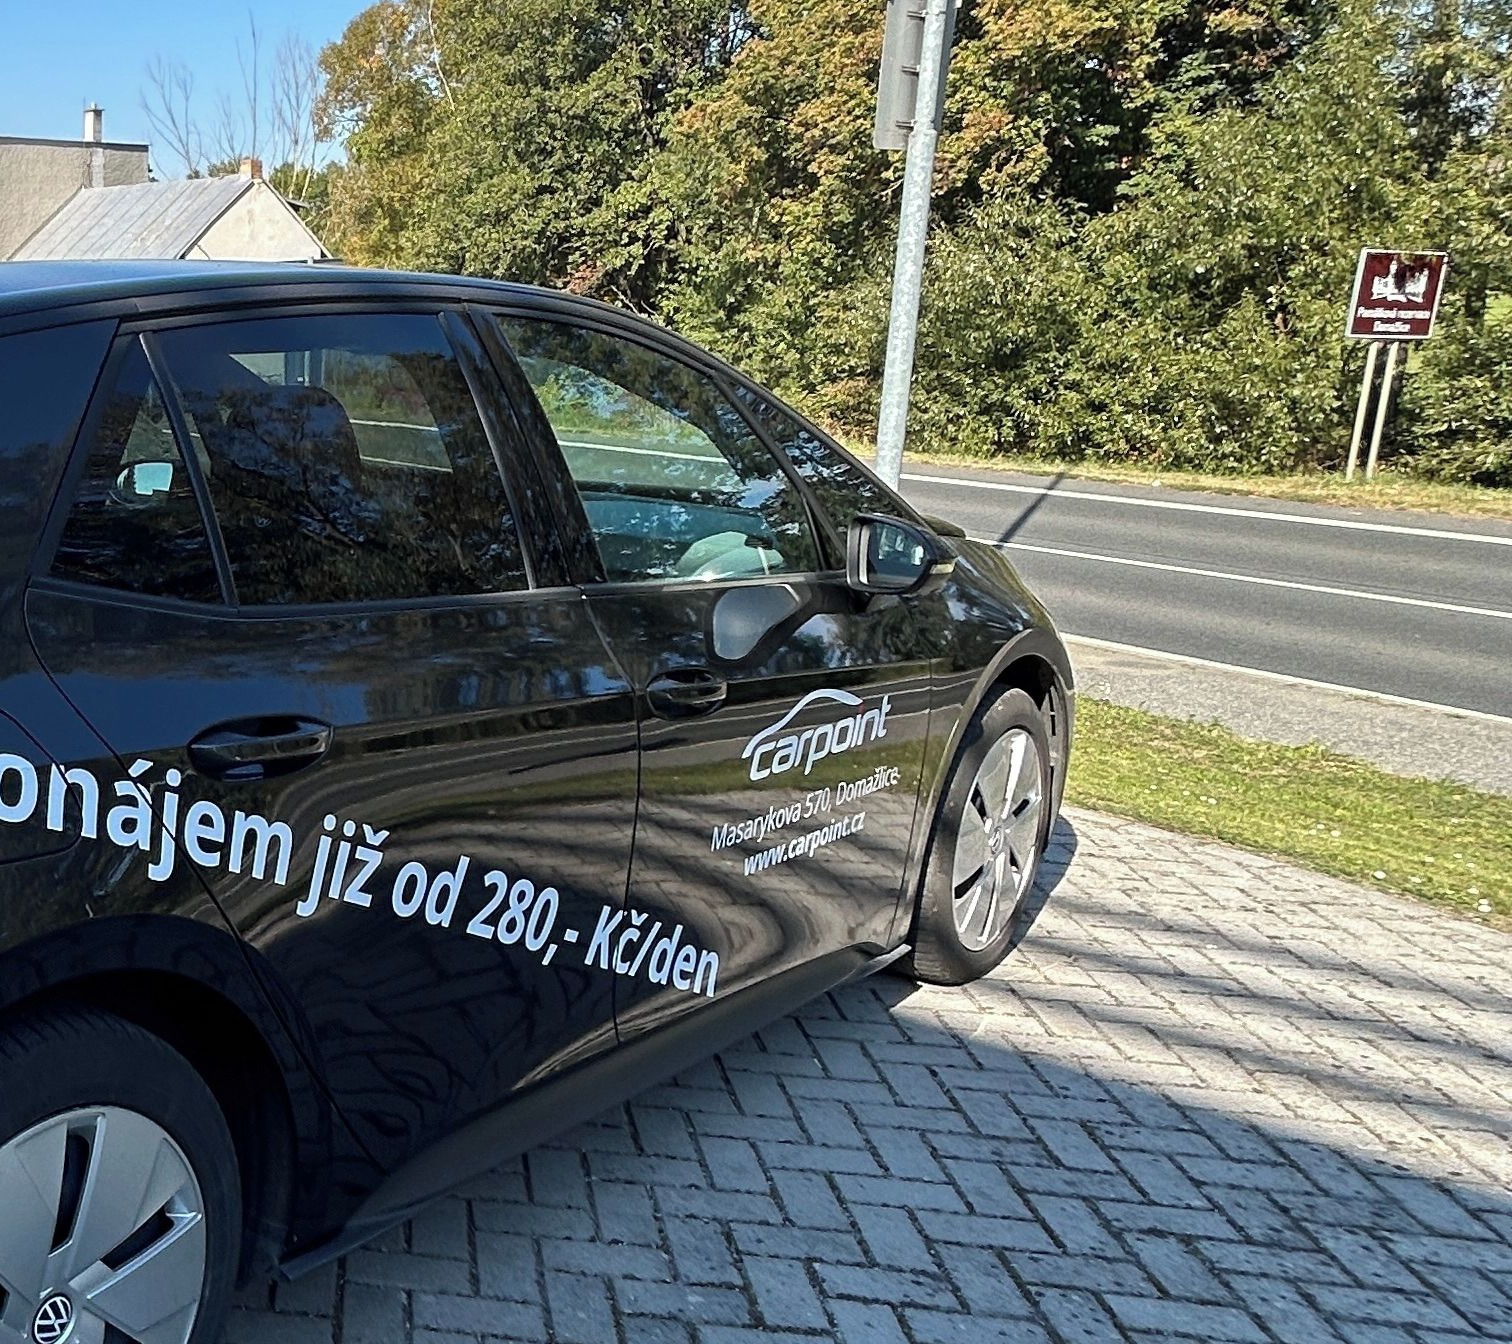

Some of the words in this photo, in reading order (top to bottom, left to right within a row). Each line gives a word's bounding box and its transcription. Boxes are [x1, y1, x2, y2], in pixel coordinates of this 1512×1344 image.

[710, 802, 802, 852] Masarykova
[803, 787, 832, 819] 570,
[835, 766, 901, 806] Domažlice
[743, 811, 867, 877] www.carpoint.cz
[296, 814, 390, 917] již
[391, 855, 471, 928] od
[466, 870, 580, 966] 280,-
[584, 904, 720, 998] Kč/den
